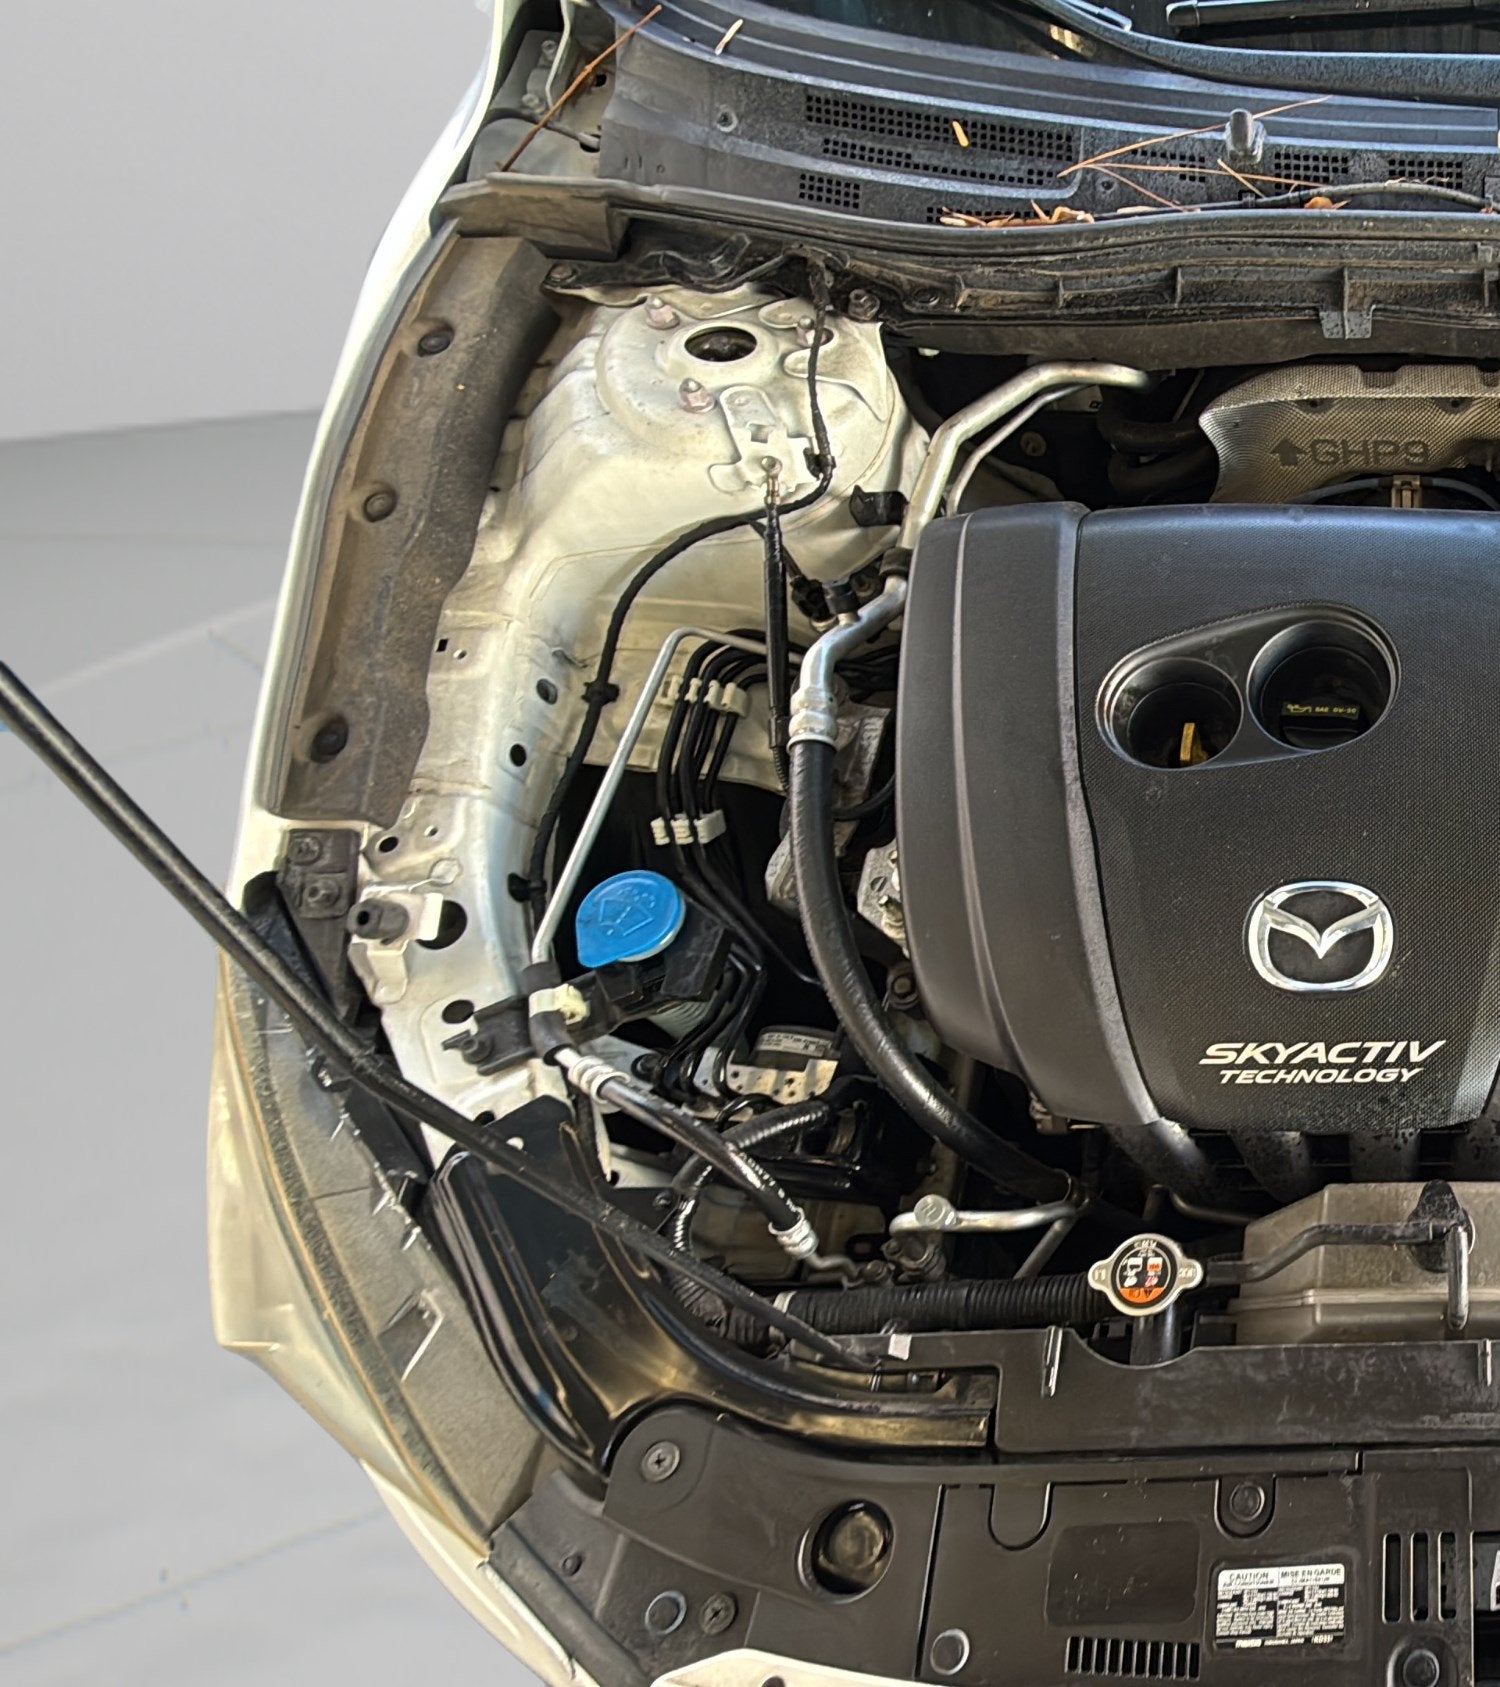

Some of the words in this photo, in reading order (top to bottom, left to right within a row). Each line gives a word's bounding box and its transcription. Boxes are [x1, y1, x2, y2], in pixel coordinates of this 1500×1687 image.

[1309, 438, 1430, 468] GHP9
[1198, 1040, 1447, 1065] SKYACTIV
[1219, 1067, 1424, 1085] TECHNOLOGY
[1230, 1572, 1269, 1580] CAUTION
